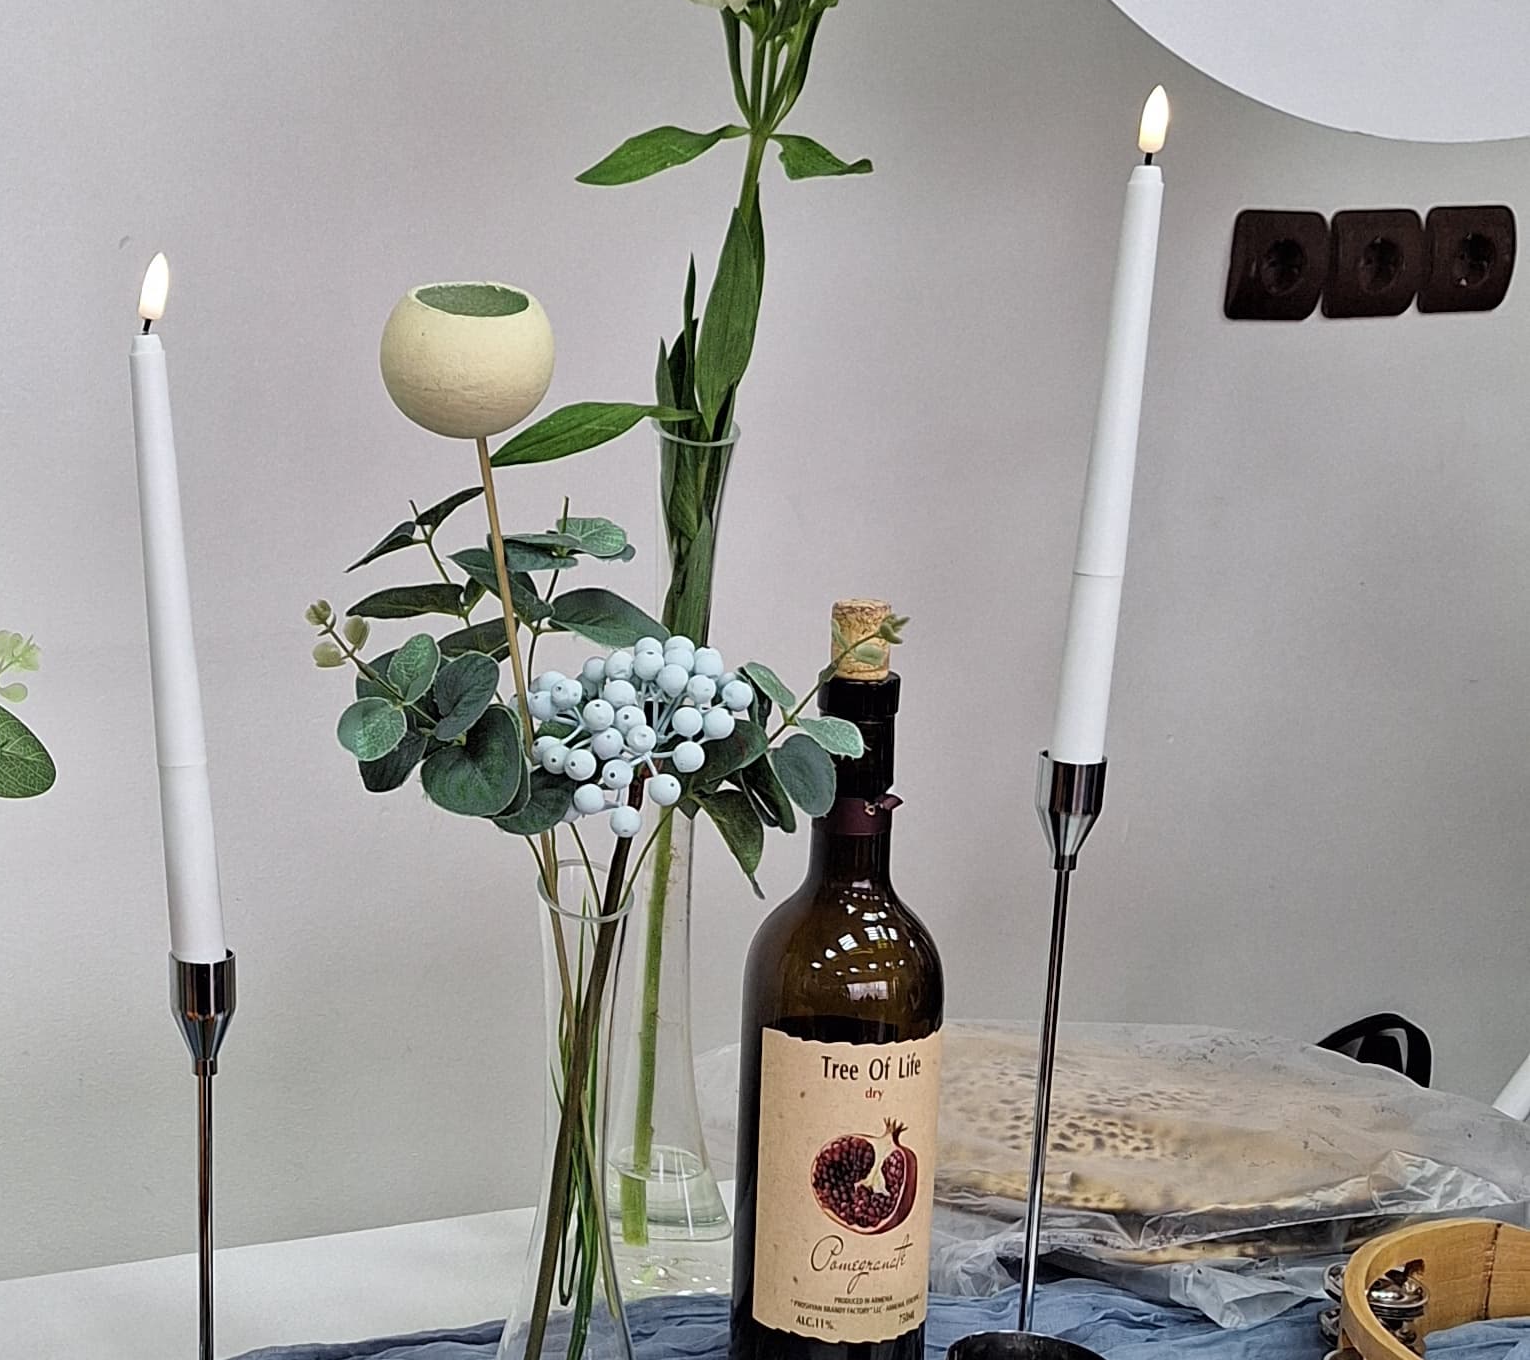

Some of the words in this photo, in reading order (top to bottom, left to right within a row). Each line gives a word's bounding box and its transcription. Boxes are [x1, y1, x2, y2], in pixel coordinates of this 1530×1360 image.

[821, 1055, 859, 1081] Tree
[869, 1056, 892, 1081] Of
[898, 1052, 921, 1079] Life
[865, 1087, 885, 1101] dry
[810, 1234, 913, 1295] Pomegranate
